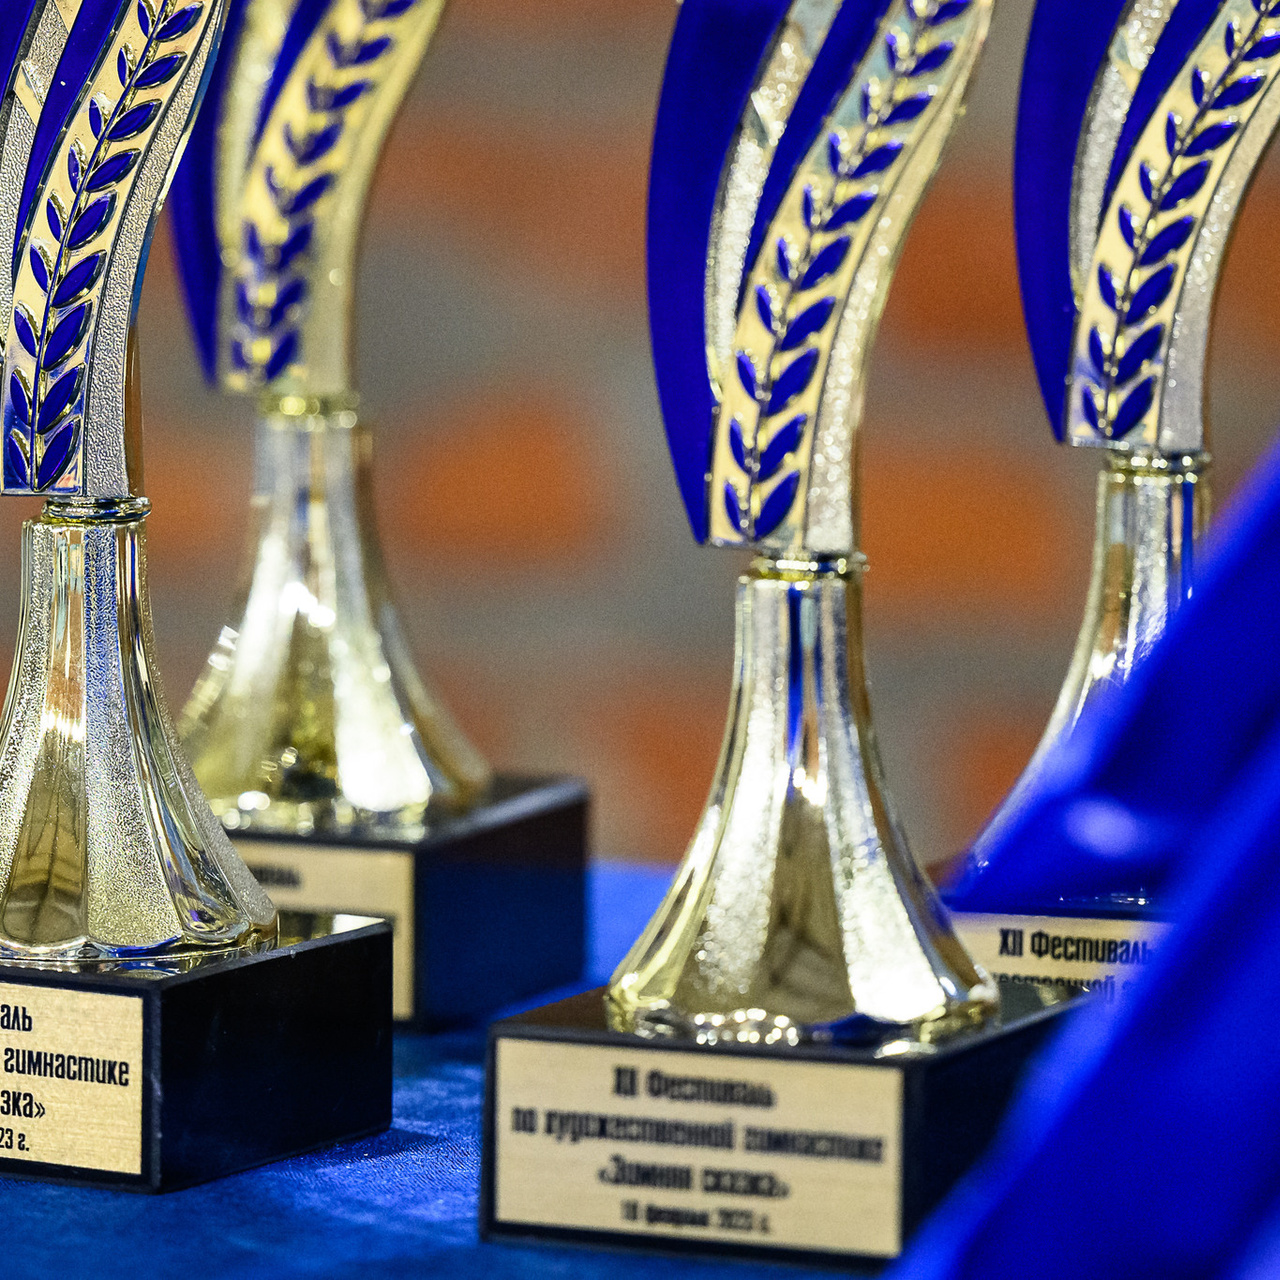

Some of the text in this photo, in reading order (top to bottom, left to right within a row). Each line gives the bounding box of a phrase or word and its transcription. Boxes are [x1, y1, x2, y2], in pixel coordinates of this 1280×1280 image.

[999, 927, 1023, 956] XII
[4, 1047, 130, 1087] гимнастике
[17, 1132, 30, 1152] г.
